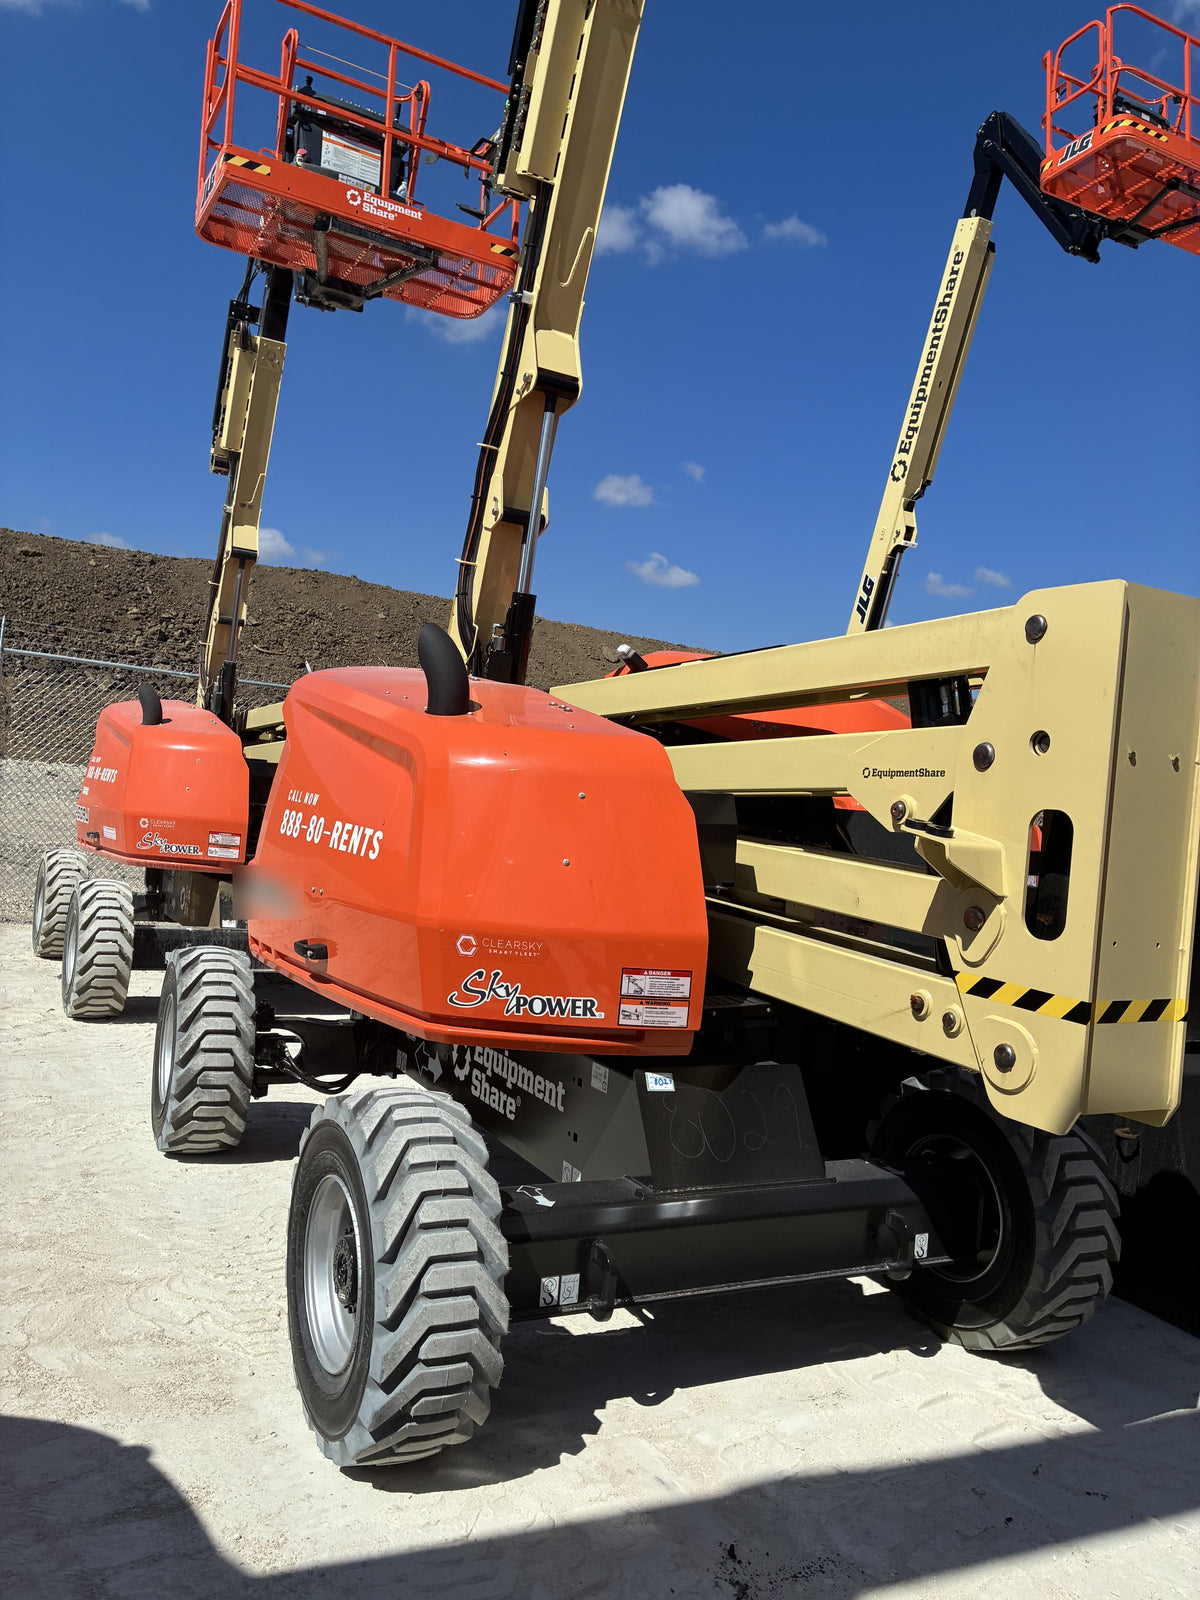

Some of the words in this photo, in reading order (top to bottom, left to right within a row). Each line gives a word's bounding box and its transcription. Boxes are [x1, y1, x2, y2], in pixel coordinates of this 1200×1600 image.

[1058, 130, 1094, 166] JLG
[361, 203, 396, 220] Share
[362, 191, 423, 220] Equipment
[898, 251, 965, 456] EquipmentShare
[855, 573, 875, 626] JLG
[871, 767, 946, 779] EquipmentShare
[287, 789, 303, 803] CALL
[303, 792, 320, 806] NOW
[280, 808, 384, 860] 888-80-RENTS
[482, 937, 544, 951] CLEARSKY
[488, 948, 513, 956] SMART
[471, 1068, 516, 1120] Share
[473, 1046, 566, 1112] Equipment
